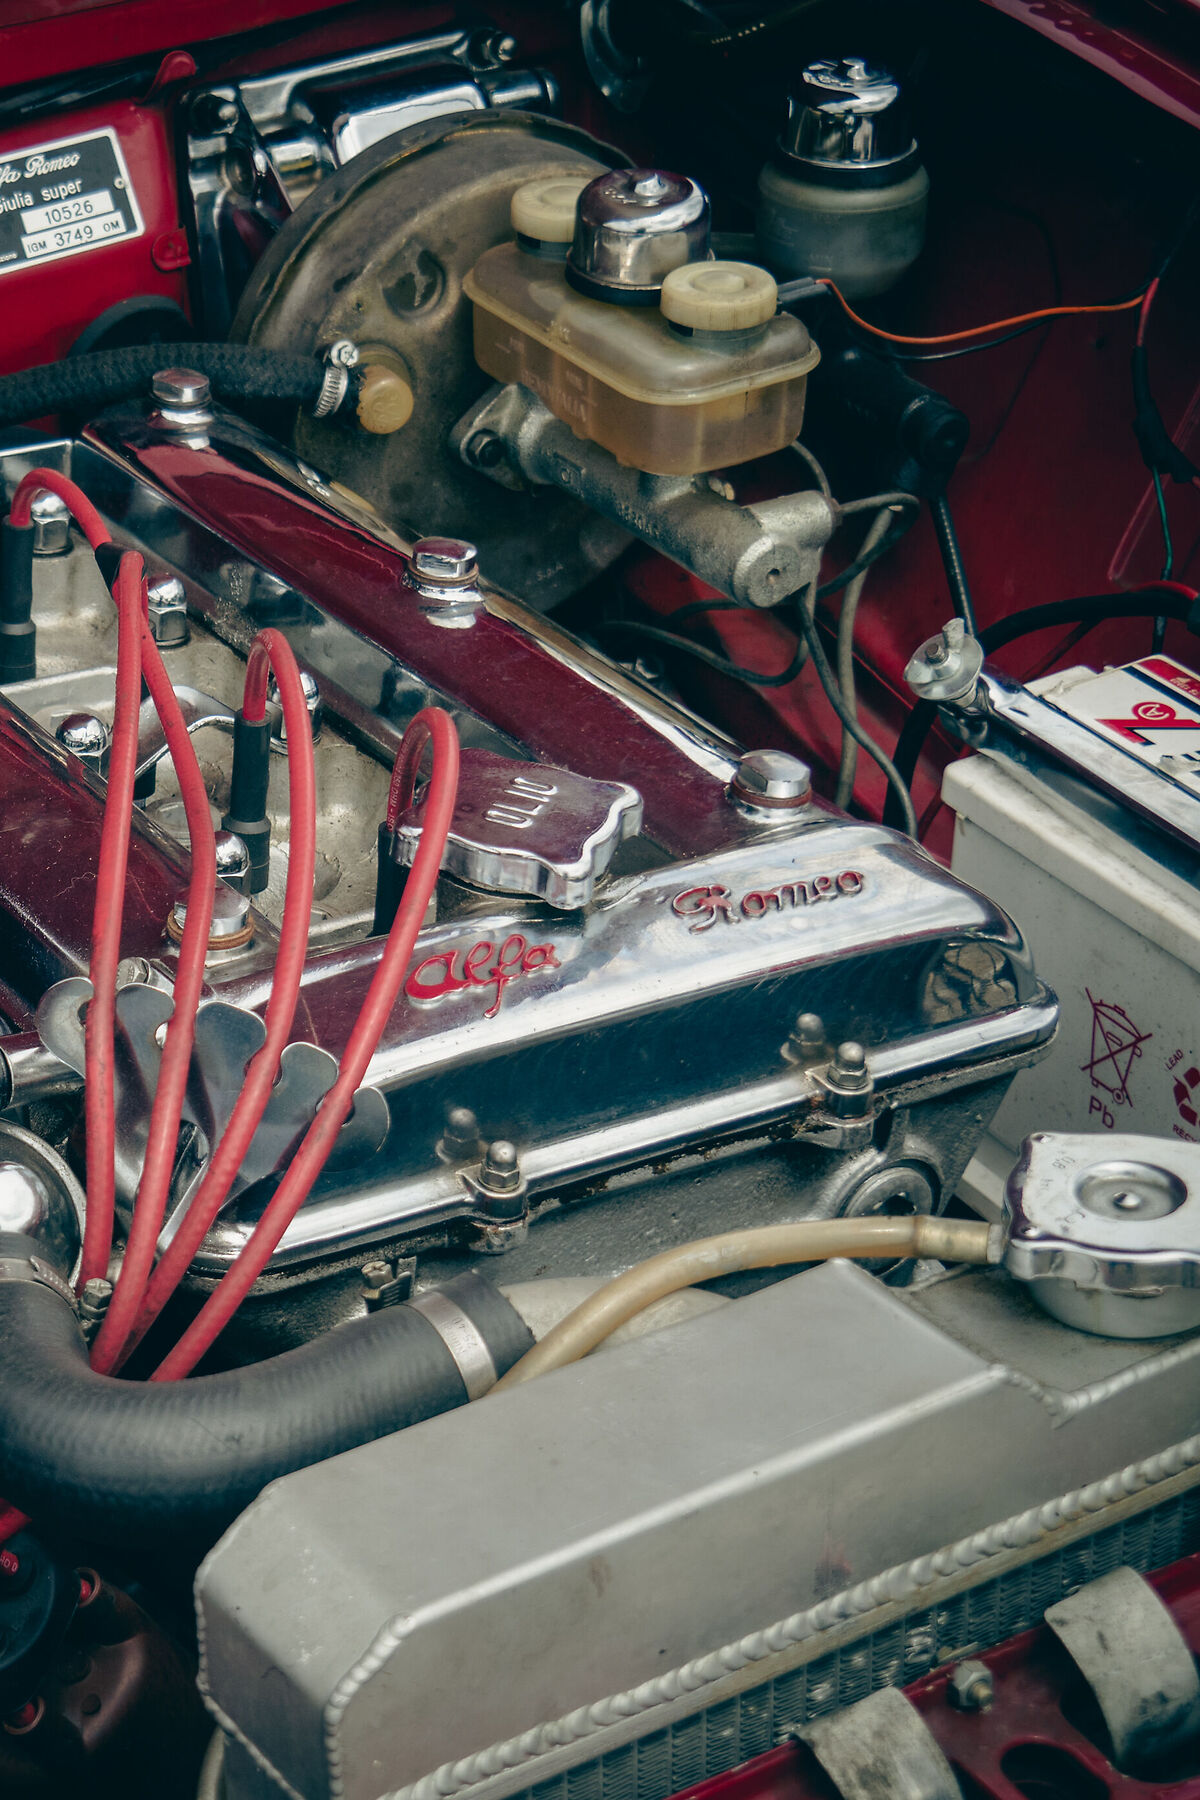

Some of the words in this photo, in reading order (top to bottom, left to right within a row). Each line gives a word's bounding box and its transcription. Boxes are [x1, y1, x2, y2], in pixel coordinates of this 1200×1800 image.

[24, 152, 81, 179] Romeo
[40, 178, 83, 201] super
[45, 199, 94, 225] 10526
[27, 240, 48, 254] IGM
[54, 225, 94, 247] 3749
[103, 220, 120, 232] OM
[484, 776, 558, 829] OLIO
[404, 933, 562, 1020] Alfa
[671, 870, 866, 936] Romeo
[1164, 1048, 1184, 1071] LEAD
[1088, 1094, 1115, 1130] Pb
